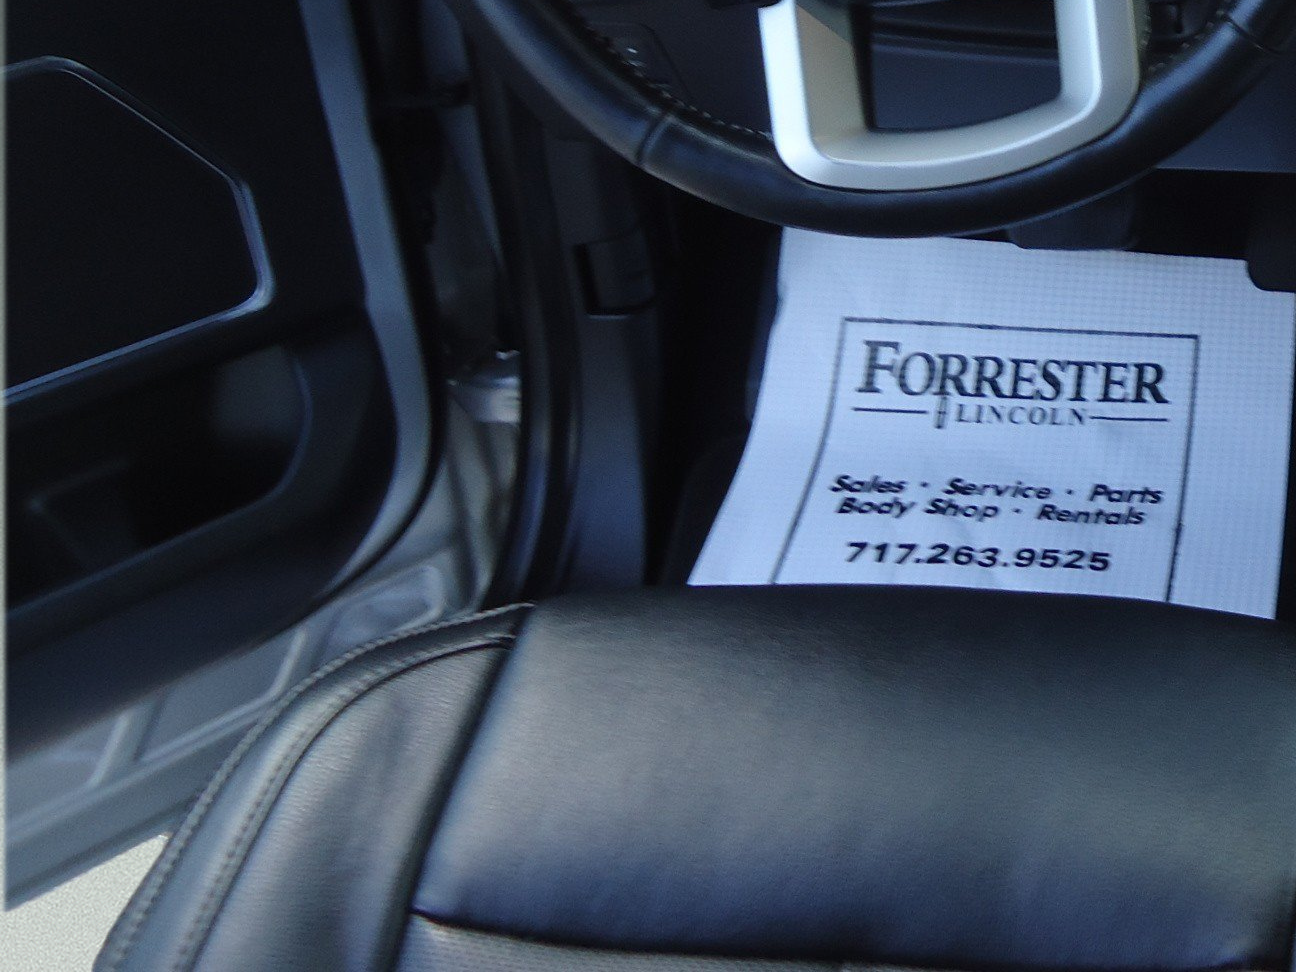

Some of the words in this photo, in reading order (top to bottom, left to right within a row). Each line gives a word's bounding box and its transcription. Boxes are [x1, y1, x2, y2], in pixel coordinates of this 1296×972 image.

[856, 339, 1171, 405] FORRESTER
[955, 403, 1087, 426] LINCOLN
[829, 474, 906, 495] Sales
[944, 476, 1052, 501] Service
[1089, 483, 1165, 505] Parts
[836, 497, 917, 519] Body
[925, 497, 999, 522] Shop
[1036, 504, 1146, 526] Rentals
[845, 541, 1112, 573] 717.263.9525
